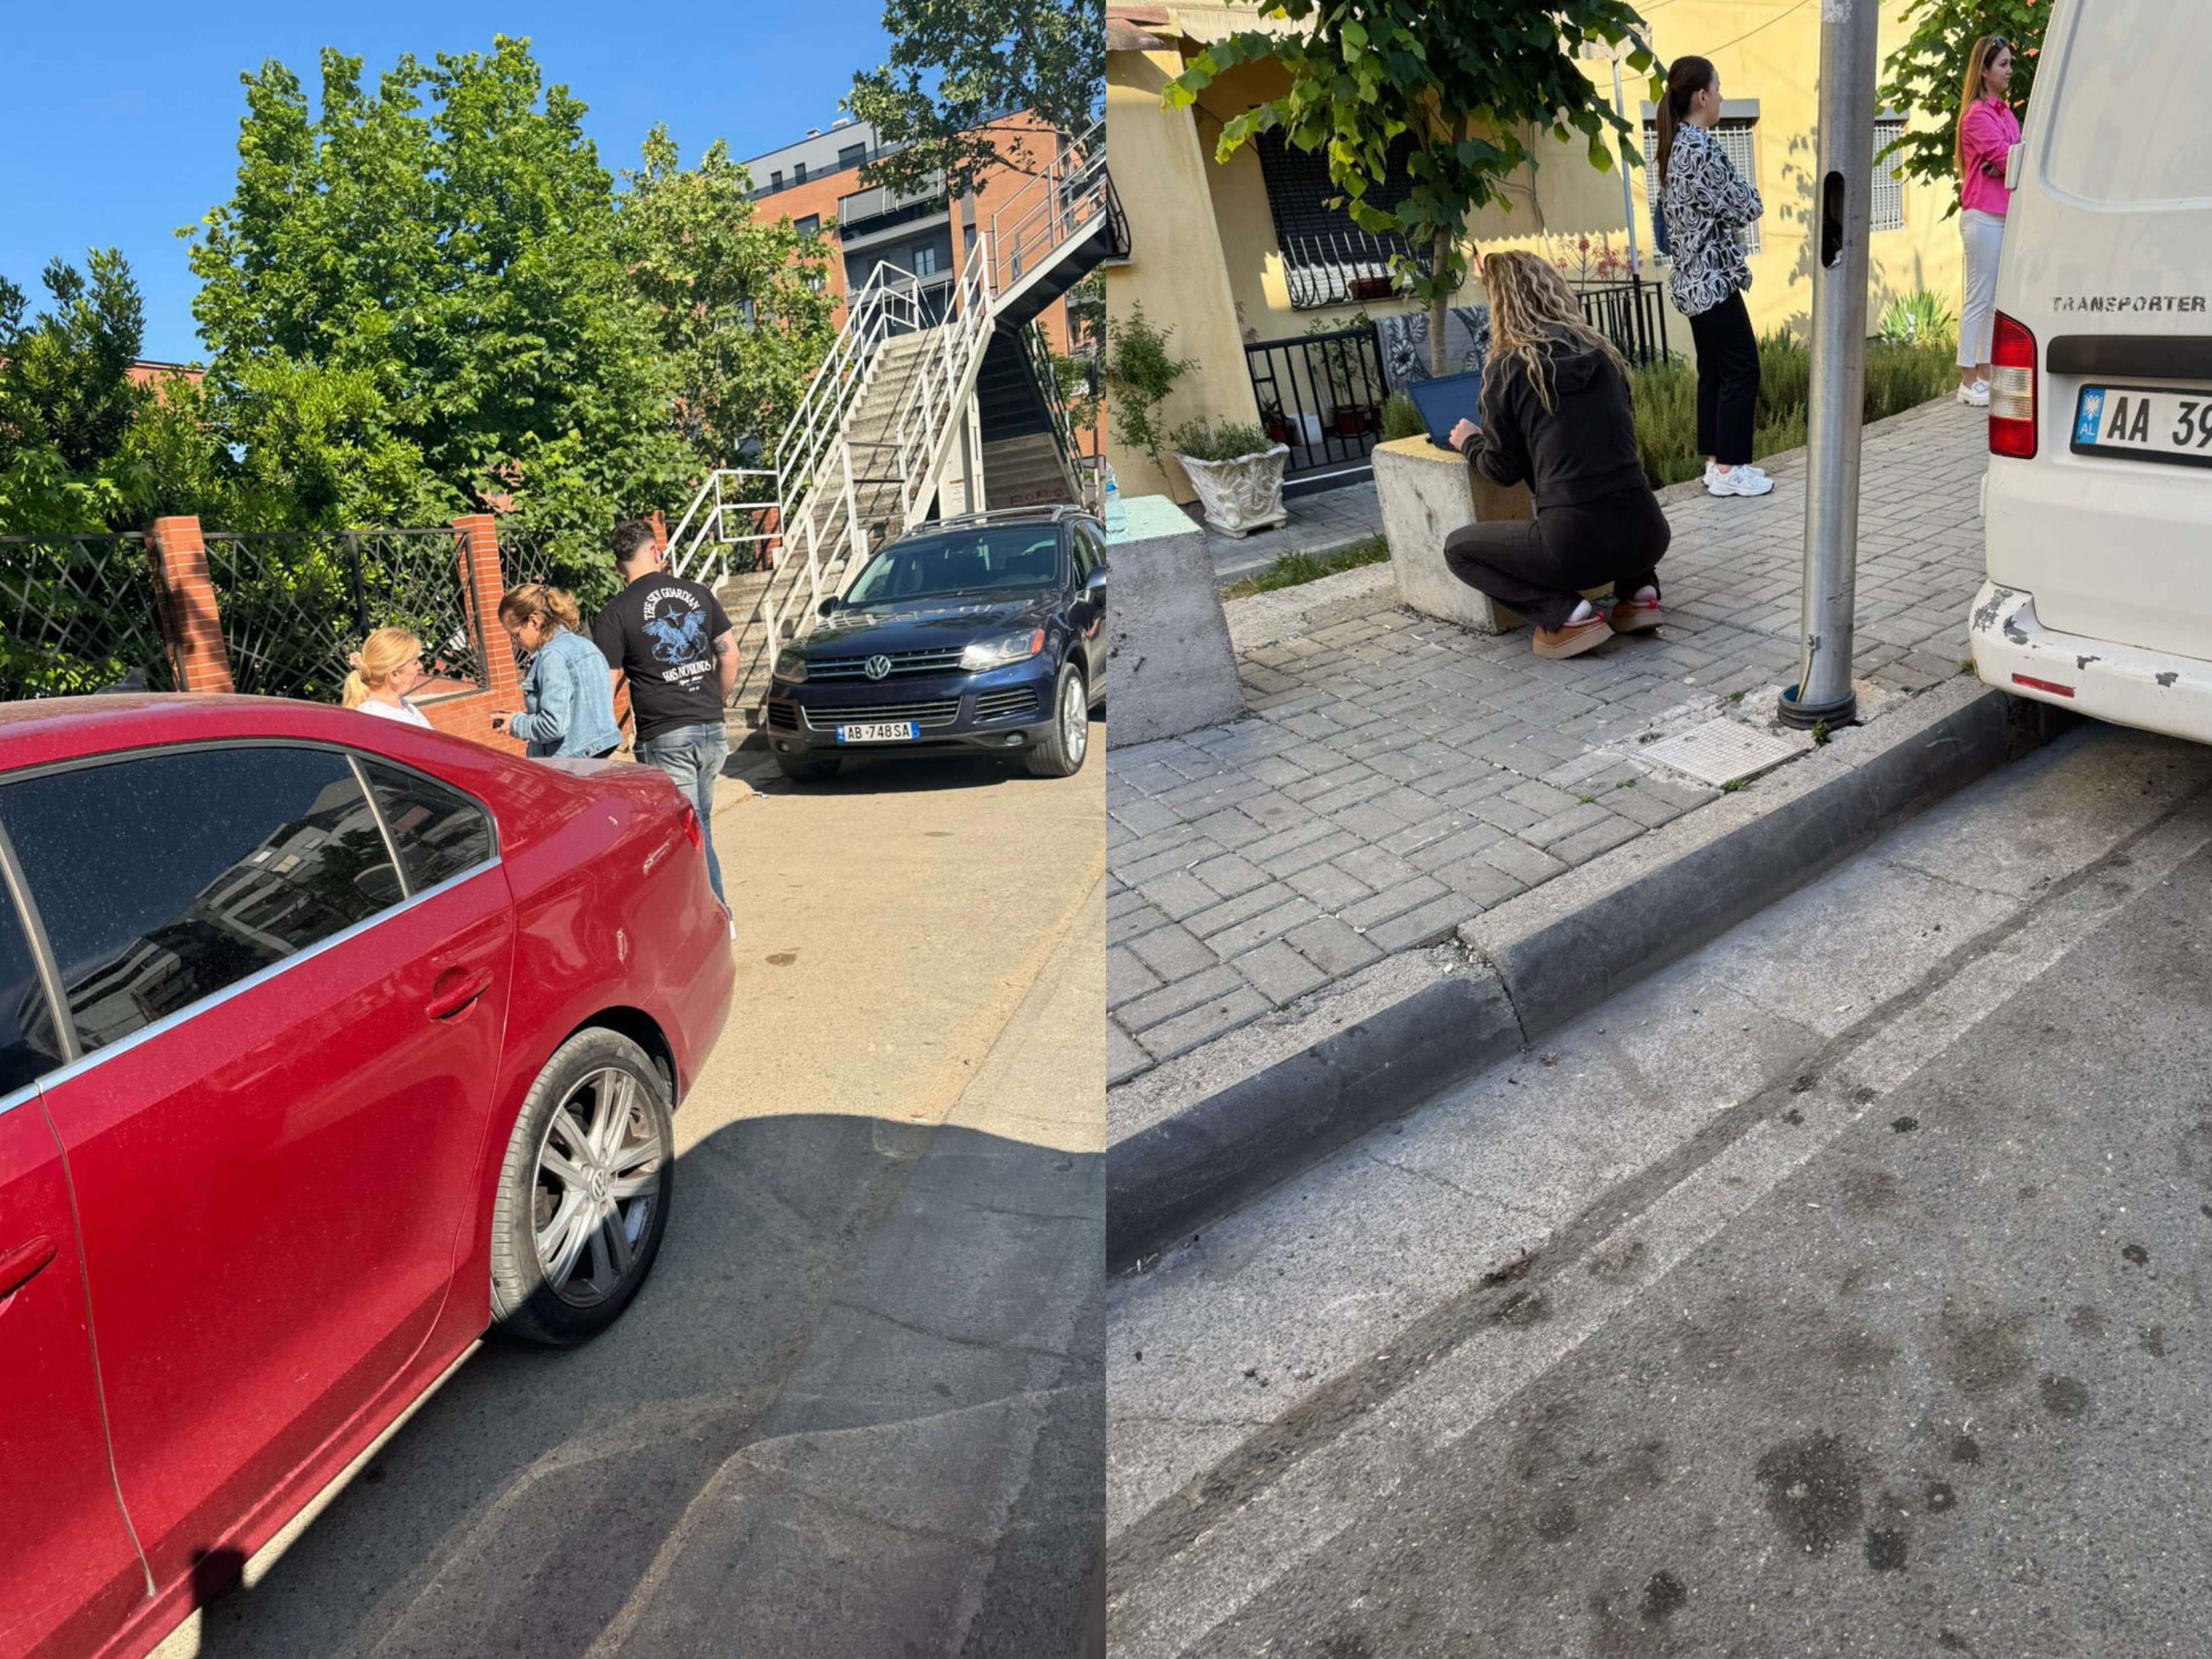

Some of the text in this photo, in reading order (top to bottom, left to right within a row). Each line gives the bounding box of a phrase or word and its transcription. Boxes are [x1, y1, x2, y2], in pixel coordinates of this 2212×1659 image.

[2054, 296, 2206, 312] TRANSPORTER
[2107, 397, 2150, 442] AA
[2080, 423, 2095, 435] AL
[644, 601, 655, 620] THE
[660, 587, 701, 610] GUARDIAN
[662, 668, 678, 682] HAS
[848, 727, 861, 738] AB
